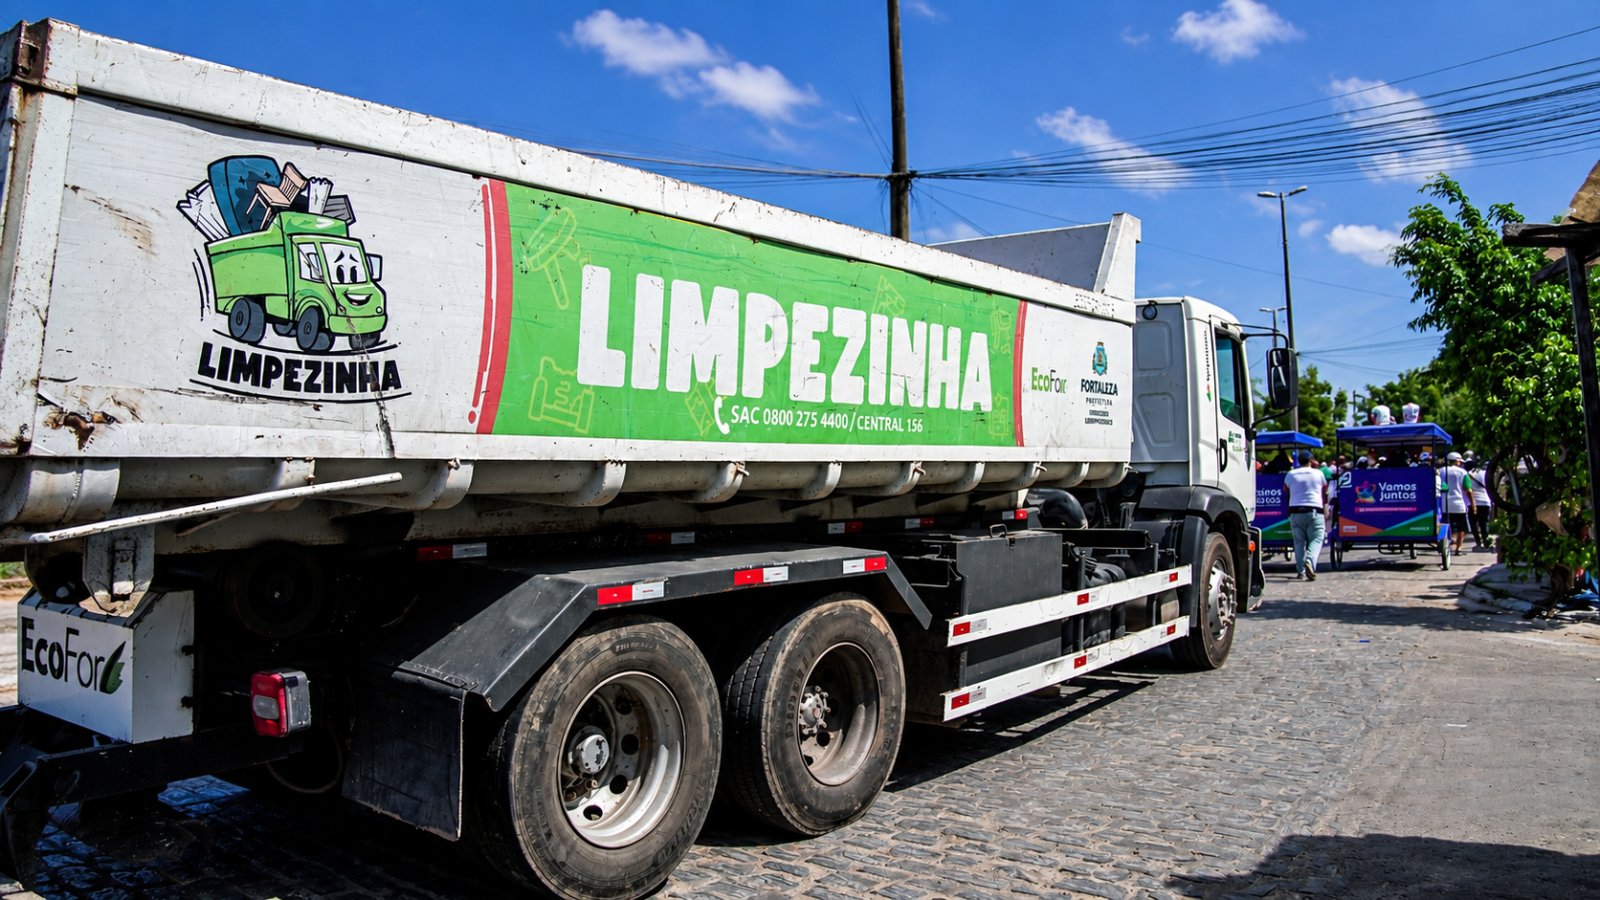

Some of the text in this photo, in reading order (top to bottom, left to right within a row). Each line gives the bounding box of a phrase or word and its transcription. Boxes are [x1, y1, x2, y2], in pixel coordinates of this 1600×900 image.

[577, 265, 992, 411] LIMPEZINHA
[198, 342, 402, 394] LIMPEZINHA
[1080, 379, 1118, 396] FORTALEZA
[731, 404, 760, 424] SAC
[763, 408, 793, 427] 0800
[796, 411, 817, 428] 275
[907, 418, 923, 432] 156
[1379, 482, 1417, 491] Vamos
[21, 616, 105, 691] EcoFor
